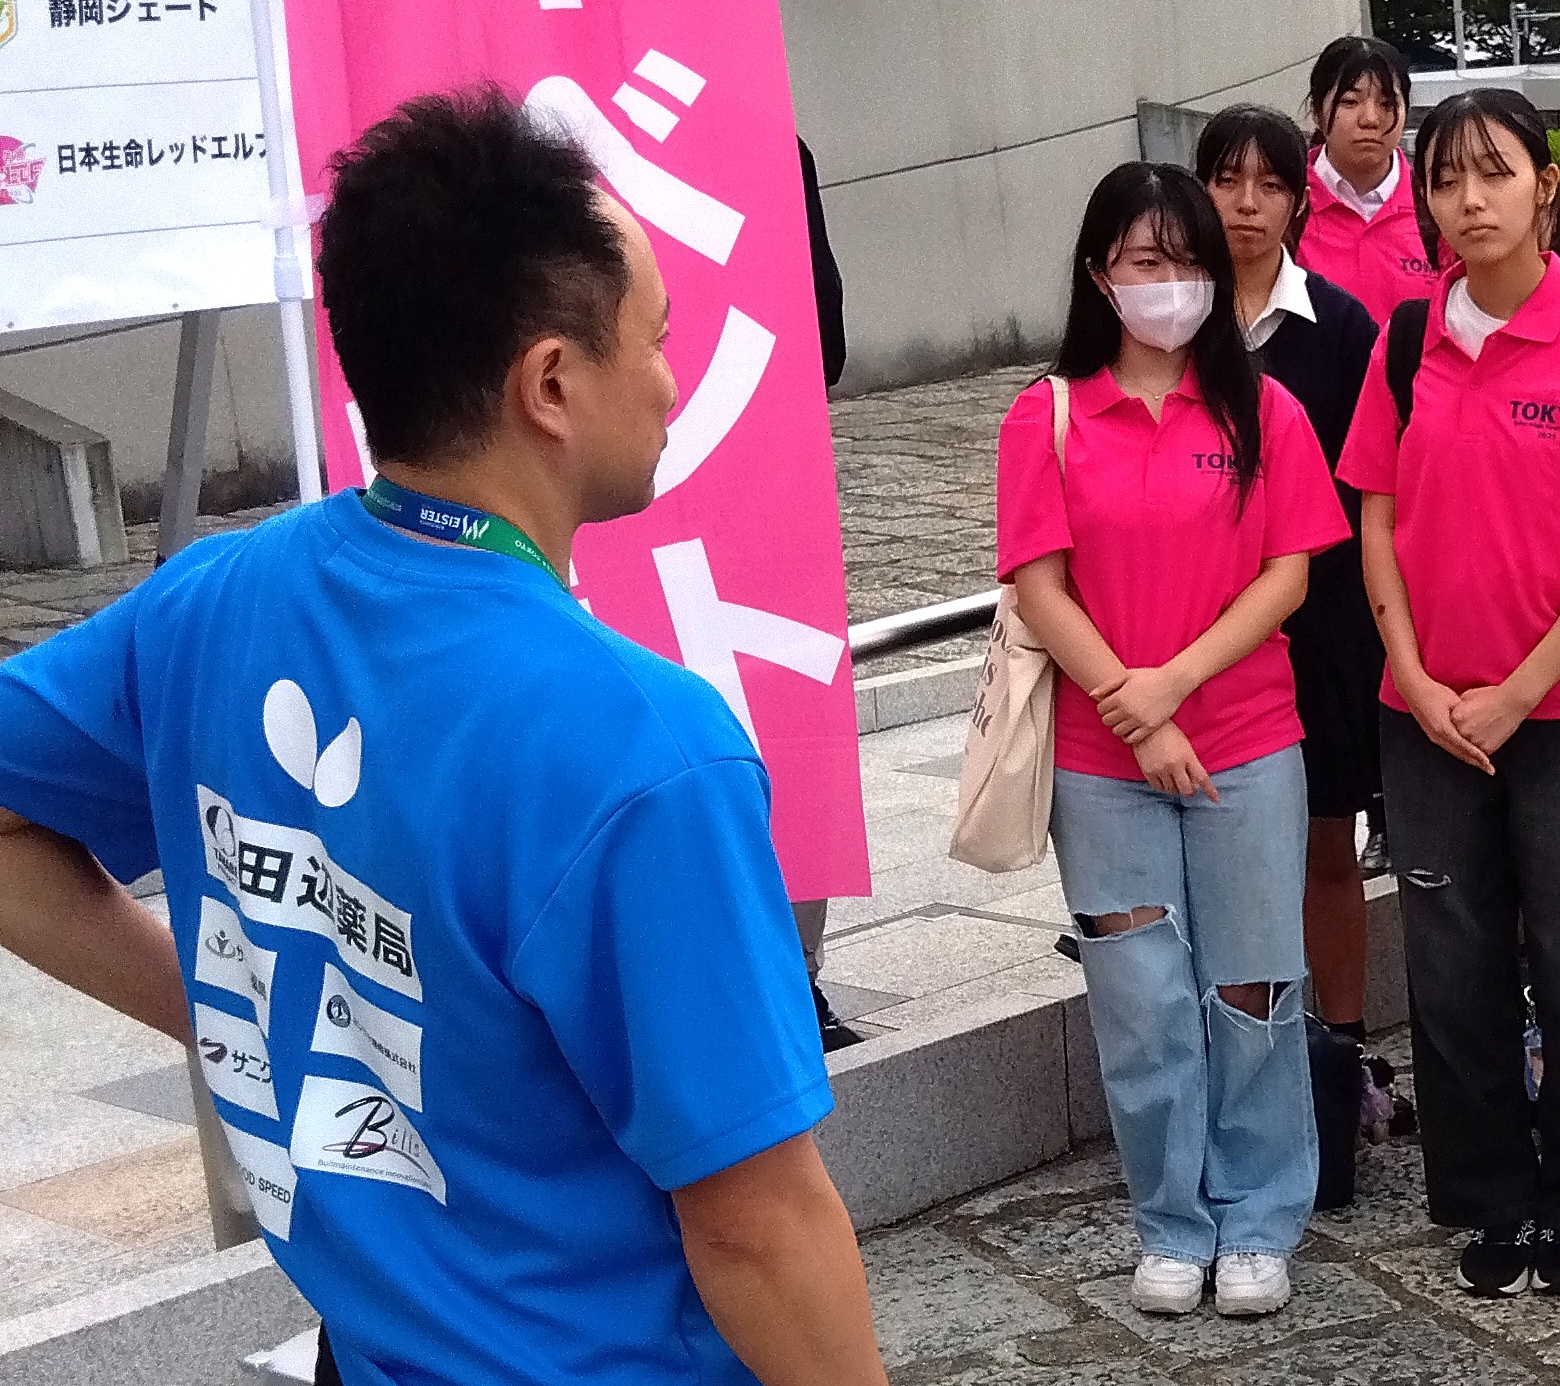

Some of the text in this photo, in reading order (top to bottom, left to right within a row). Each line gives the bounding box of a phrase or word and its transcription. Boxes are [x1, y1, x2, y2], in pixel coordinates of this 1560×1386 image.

[238, 839, 413, 978] 田辺薬局
[257, 1175, 291, 1204] SPEED
